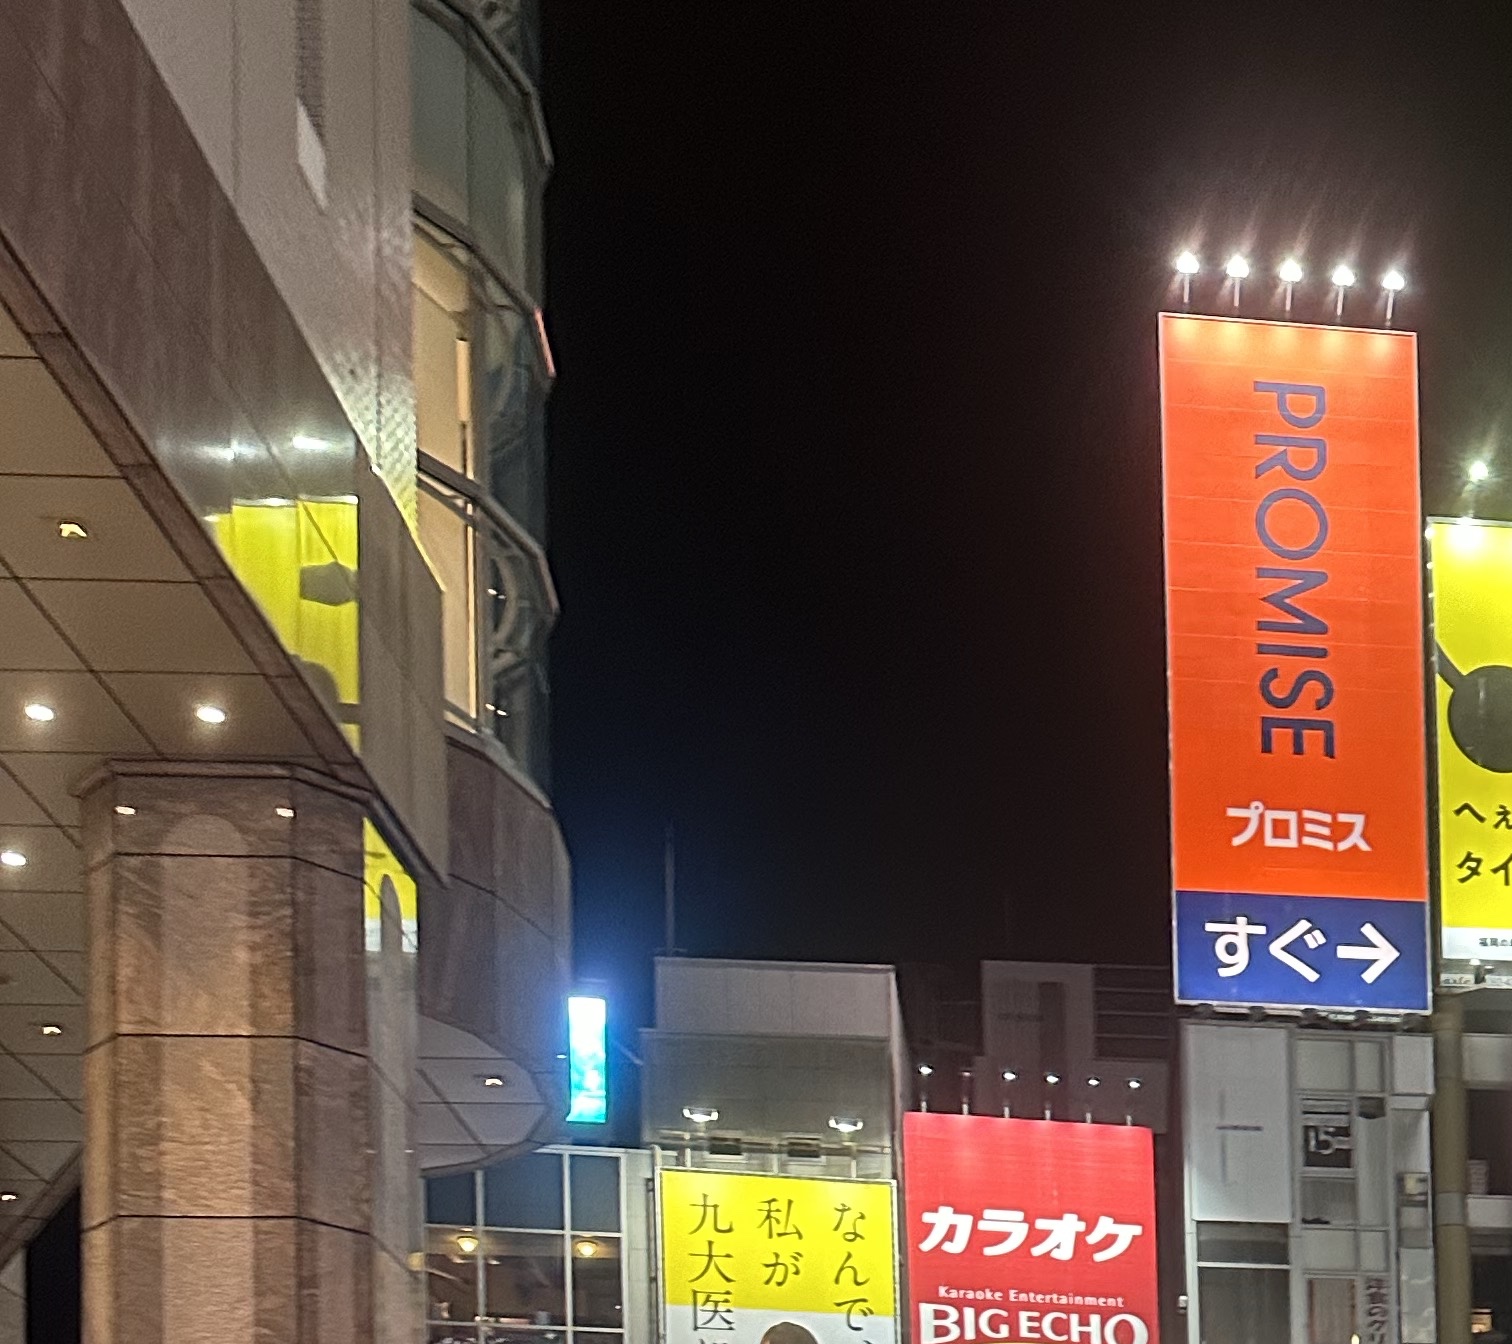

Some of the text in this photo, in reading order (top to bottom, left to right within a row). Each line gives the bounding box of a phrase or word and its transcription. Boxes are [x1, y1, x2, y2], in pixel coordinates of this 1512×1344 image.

[1253, 379, 1336, 760] PROMISE
[1225, 801, 1373, 854] プロミス
[1204, 915, 1328, 984] すぐ
[756, 1196, 804, 1289] 私が
[917, 1205, 1143, 1263] カラオケ
[938, 1286, 1125, 1308] Karaoke Entertainment
